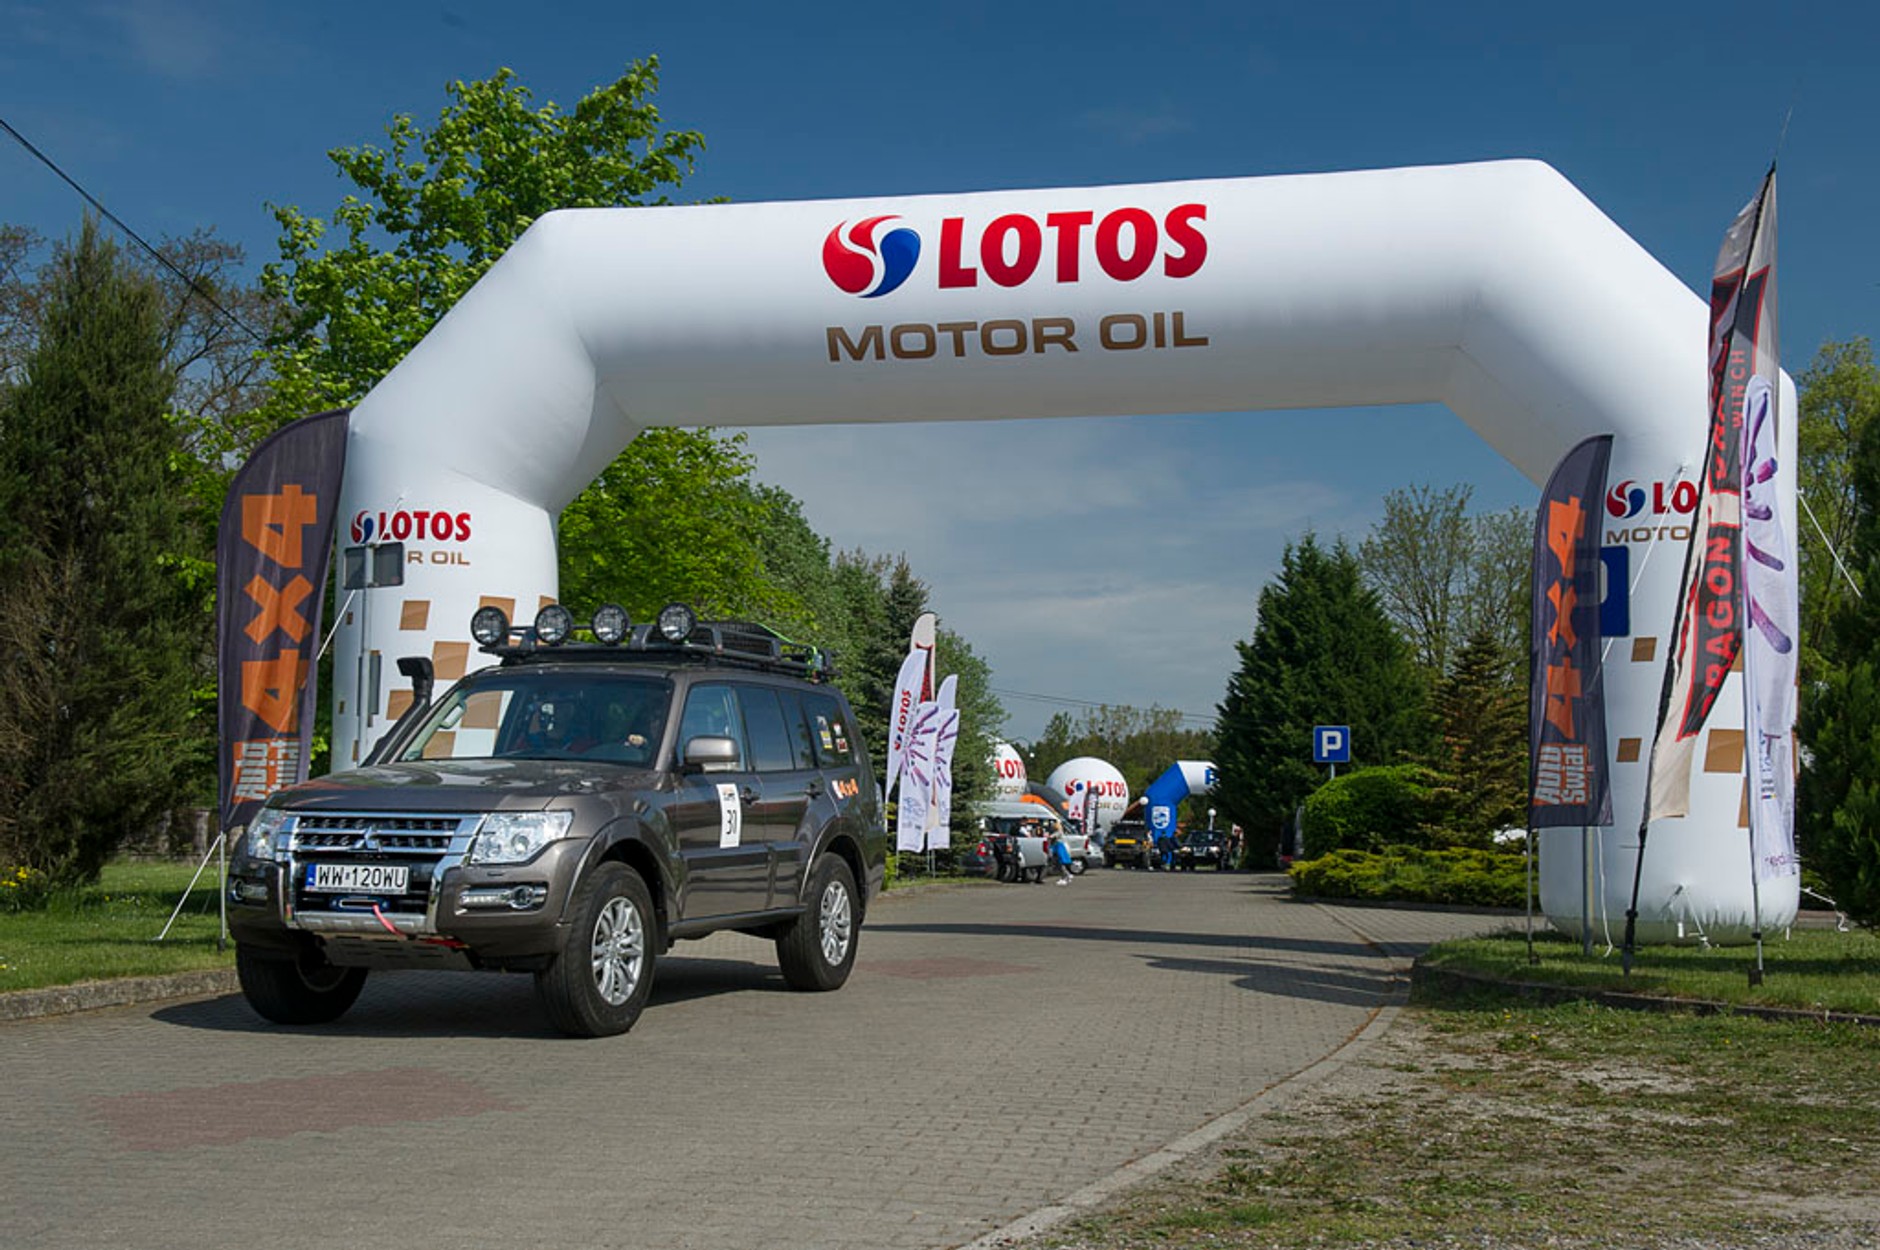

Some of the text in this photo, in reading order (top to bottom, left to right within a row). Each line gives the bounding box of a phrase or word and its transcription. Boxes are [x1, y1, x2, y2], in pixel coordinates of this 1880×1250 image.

[938, 203, 1208, 289] LOTOS
[826, 311, 1209, 362] MOTOR OIL
[1731, 350, 1746, 428] WINCH
[378, 510, 471, 542] LOTOS
[1606, 526, 1692, 544] MOTO
[431, 550, 471, 565] OIL
[897, 689, 912, 733] LOTOS
[1322, 730, 1342, 758] P
[319, 866, 406, 888] WW 120WU
